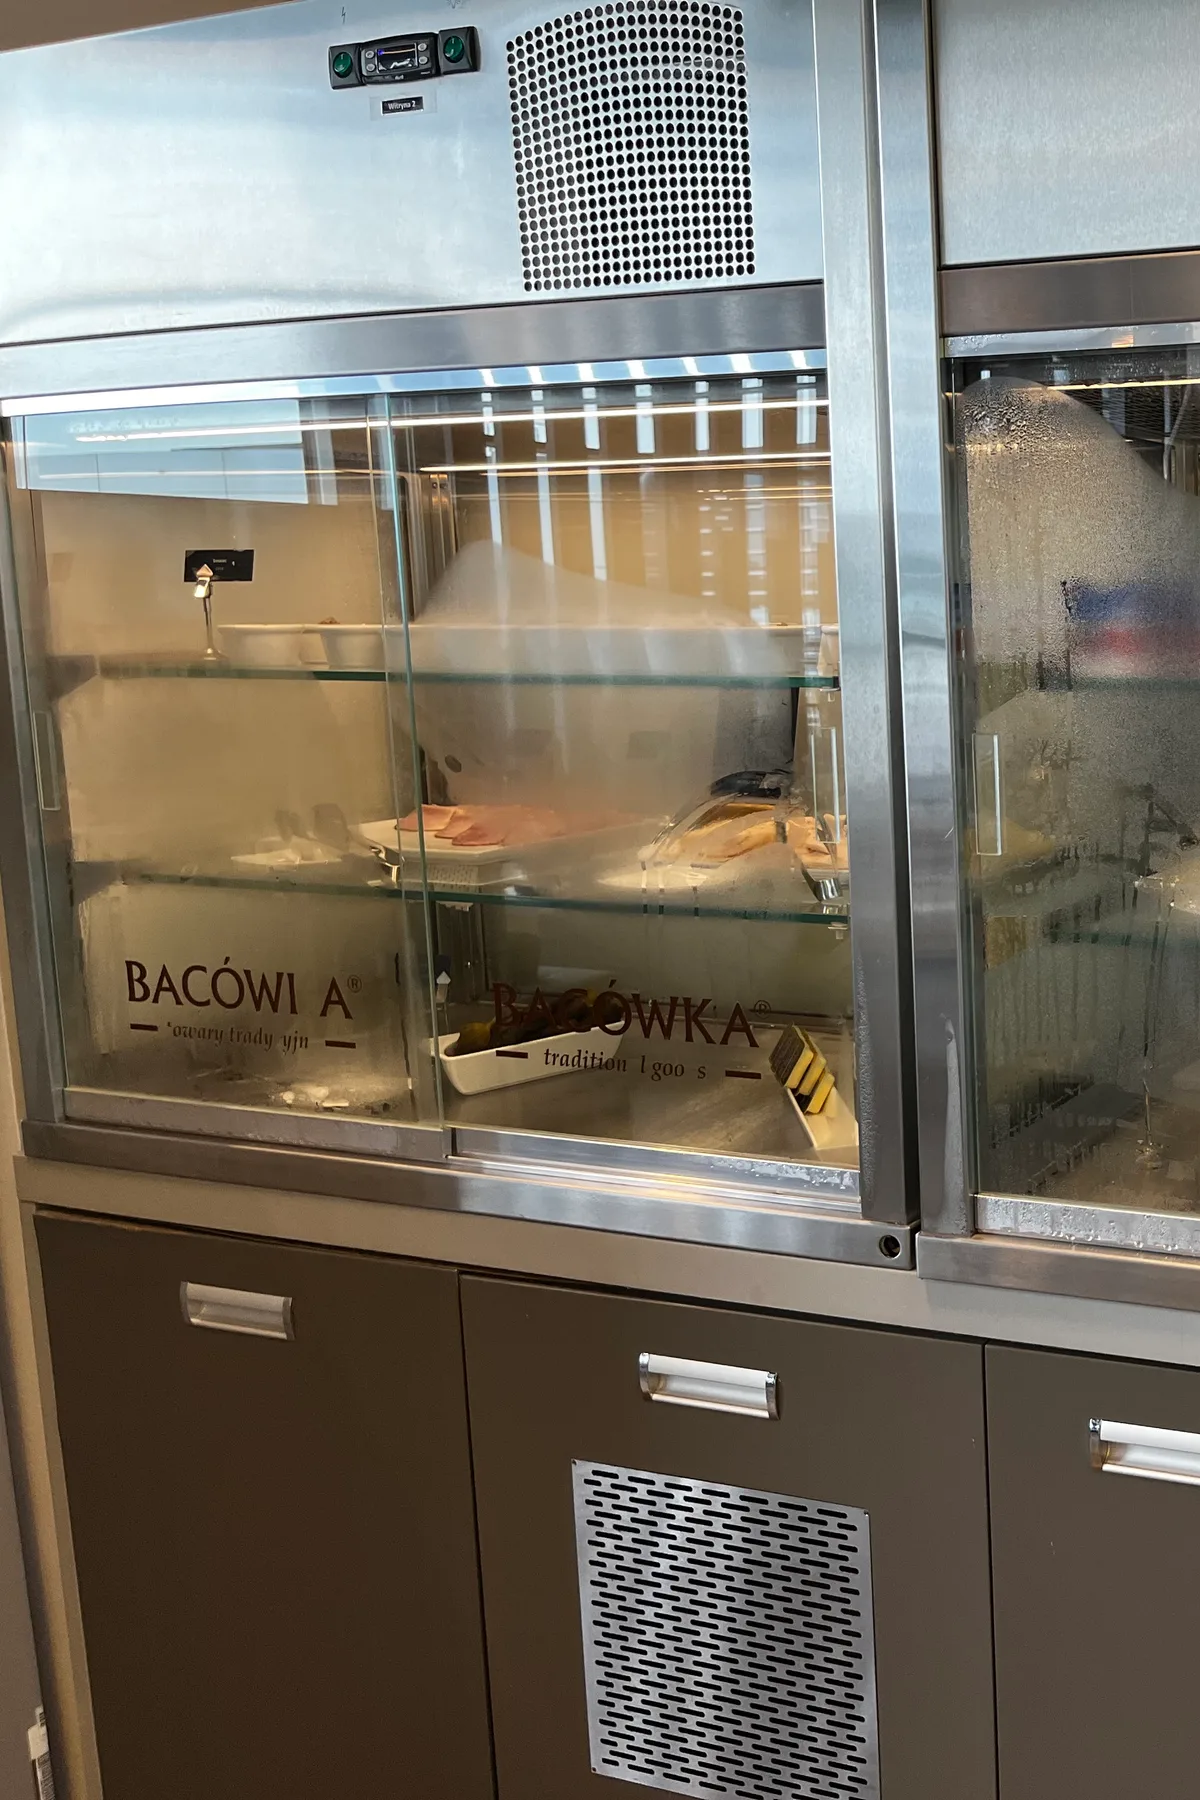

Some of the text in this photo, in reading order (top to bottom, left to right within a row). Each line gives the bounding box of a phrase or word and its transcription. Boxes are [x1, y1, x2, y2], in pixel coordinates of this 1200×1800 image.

[388, 100, 416, 110] Witryna 2
[167, 1021, 224, 1047] owary
[543, 1047, 707, 1082] traditionl goos
